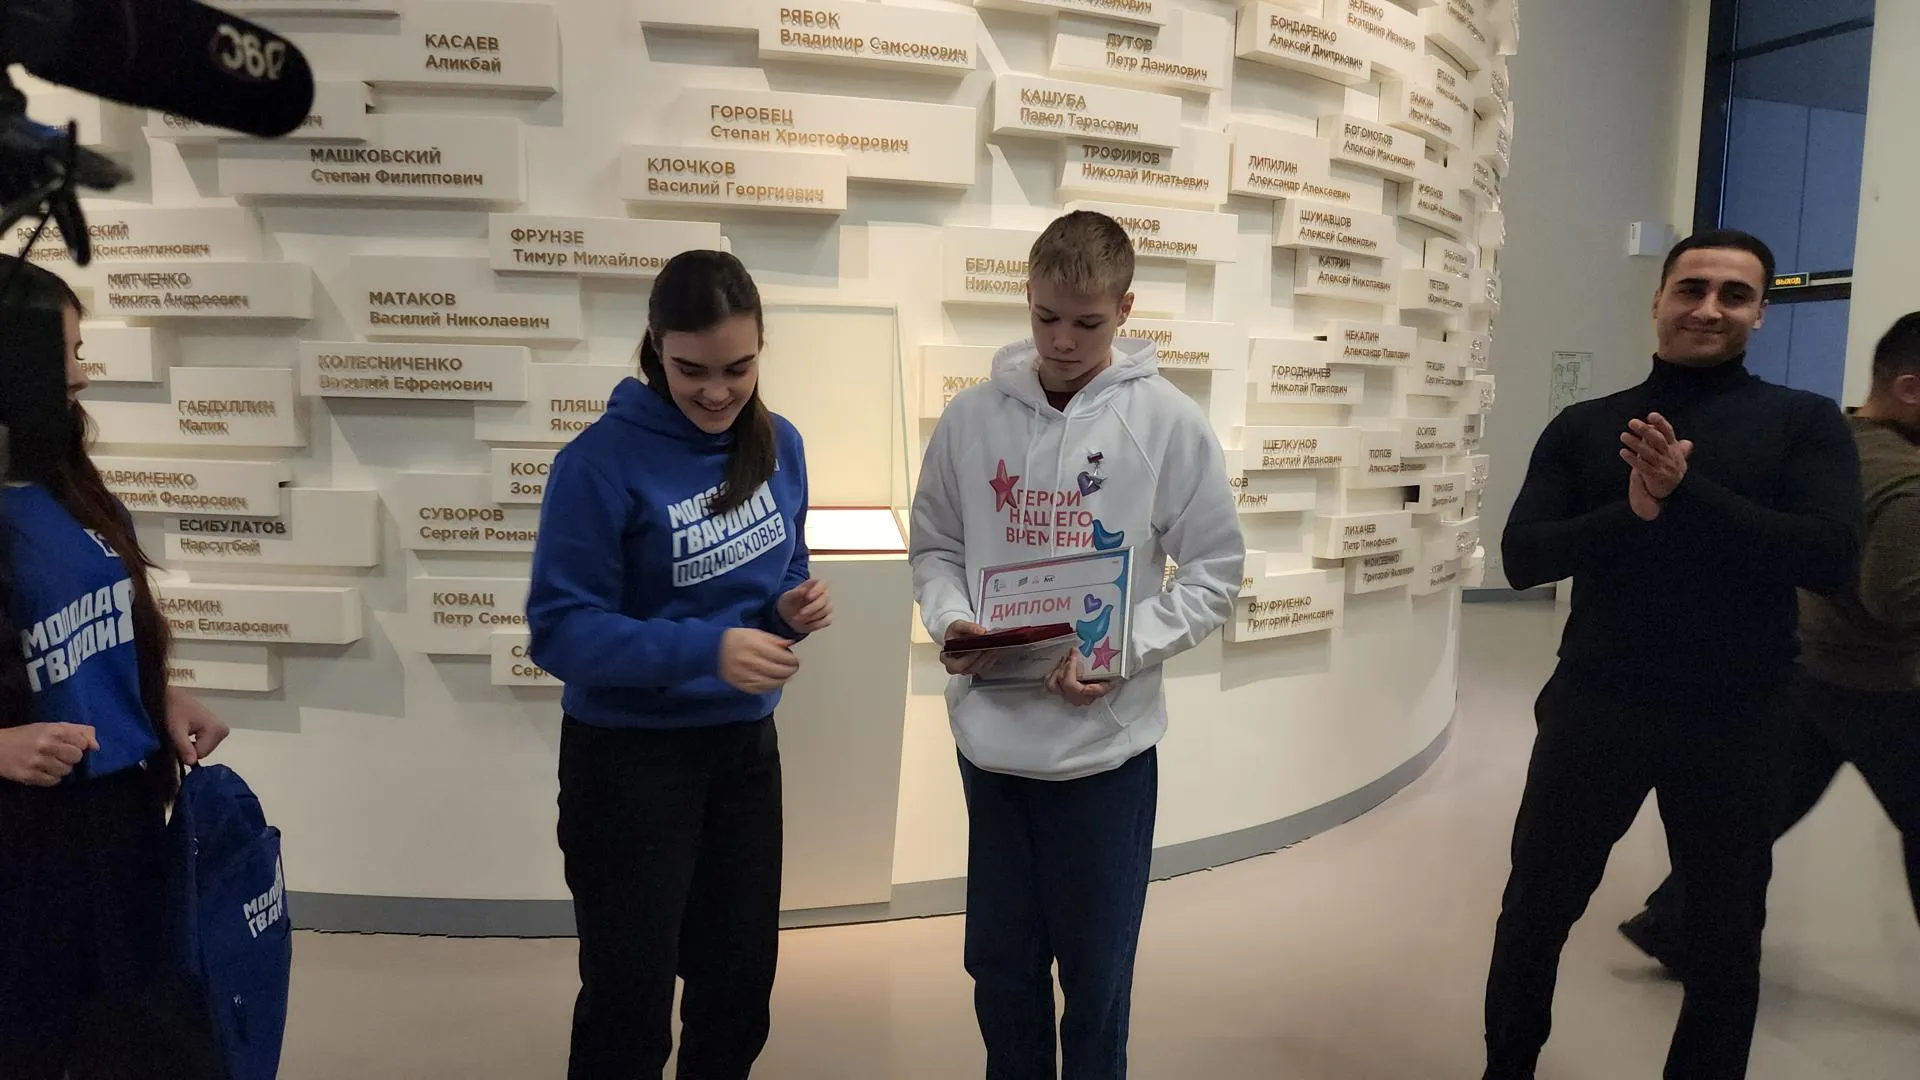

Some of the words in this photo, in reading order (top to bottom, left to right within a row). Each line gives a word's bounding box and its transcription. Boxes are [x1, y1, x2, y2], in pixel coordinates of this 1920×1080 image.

[780, 8, 840, 27] РЯБОК
[1270, 15, 1338, 42] БОНДАРЕНКО
[425, 34, 498, 50] КАСАЕВ
[780, 29, 864, 49] Владимир
[869, 37, 968, 62] Самсонович
[1107, 33, 1153, 52] ДУТОВ
[1269, 34, 1311, 53] Алексей
[425, 54, 501, 72] Аликбай
[1107, 52, 1138, 68] Петр
[1141, 57, 1208, 79] Данилович
[1020, 88, 1087, 108] КАШУБА
[711, 105, 793, 125] ГОРОБЕЦ
[1020, 108, 1064, 125] Павел
[1067, 113, 1139, 133] Тарасович
[711, 125, 771, 143] Степан
[775, 129, 909, 153] Христофорович
[1345, 123, 1393, 145] БОГОМОЛОВ
[311, 147, 441, 164] МАШКОВСКИЙ
[1083, 144, 1160, 165] ТРОФИМОВ
[647, 158, 736, 176] КЛОЧКОВ
[1249, 155, 1298, 173] ЛИПИЛИН
[311, 169, 370, 183] Степан
[375, 169, 483, 186] Филиппович
[1083, 163, 1138, 182] Николай
[1142, 169, 1209, 189] Игнатьевич
[647, 177, 720, 196] Василий
[726, 183, 825, 203] Георгиевич
[1249, 172, 1300, 192] Александр
[1302, 181, 1351, 200] Алексеевич
[1300, 209, 1351, 228] ШУМАВЦОВ
[511, 229, 584, 245] ФРУНЗЕ
[1300, 226, 1335, 242] Алексей
[93, 244, 209, 257] Константинович
[1140, 237, 1198, 252] Иванович
[513, 249, 567, 267] Тимур
[574, 252, 668, 269] Михайлови
[108, 272, 189, 286] МИТЧЕНКО
[1318, 271, 1351, 284] Алексей
[109, 292, 160, 306] Никита
[165, 292, 248, 308] Андреевич
[369, 292, 456, 306] МАТАКОВ
[369, 311, 441, 326] Василий
[446, 313, 549, 328] Николаевич
[1345, 330, 1379, 343] ЧЕКАЛИН
[1157, 350, 1209, 362] сильевич
[1344, 345, 1381, 360] Александр
[318, 355, 463, 371] КОЛЕСНИЧЕНКО
[1272, 365, 1331, 378] ГОРОДНИЧЕВ
[319, 375, 388, 391] Василий
[393, 376, 493, 393] Ефремович
[1271, 382, 1309, 396] Николай
[1311, 384, 1347, 396] Павлович
[178, 400, 275, 414] ГАБДУЛЛИН
[551, 400, 607, 412] ПЛЯШ
[179, 419, 227, 433] Малик
[1263, 439, 1317, 450] ЩЕЛКУНОВ
[1263, 456, 1301, 467] Василий
[1303, 456, 1342, 467] Иванович
[1369, 449, 1392, 458] ПОПОВ
[511, 482, 542, 495] Зоя
[113, 491, 156, 502] итрий
[160, 491, 247, 507] Федорович
[1017, 489, 1081, 506] ГЕРОИ
[1239, 493, 1268, 504] Ильич
[420, 508, 504, 521] СУВОРОВ
[1010, 509, 1093, 527] НАШЕГО
[180, 520, 285, 533] ЕСИБУЛАТОВ
[420, 527, 479, 541] Сергей
[1345, 524, 1376, 535] ЛИХАЧЕВ
[1007, 527, 1094, 548] ВРЕМЕНИ
[677, 516, 784, 583] ПОДМОСКОВЬЕ
[433, 593, 494, 607] КОВАЦ
[1249, 597, 1311, 612] ОНУФРИЕНКО
[990, 597, 1071, 621] ДИПЛОМ
[168, 620, 193, 629] лья
[198, 618, 289, 632] Елизарович
[433, 612, 473, 626] Петр
[1249, 616, 1290, 630] Григорий
[1293, 610, 1334, 622] Денисович
